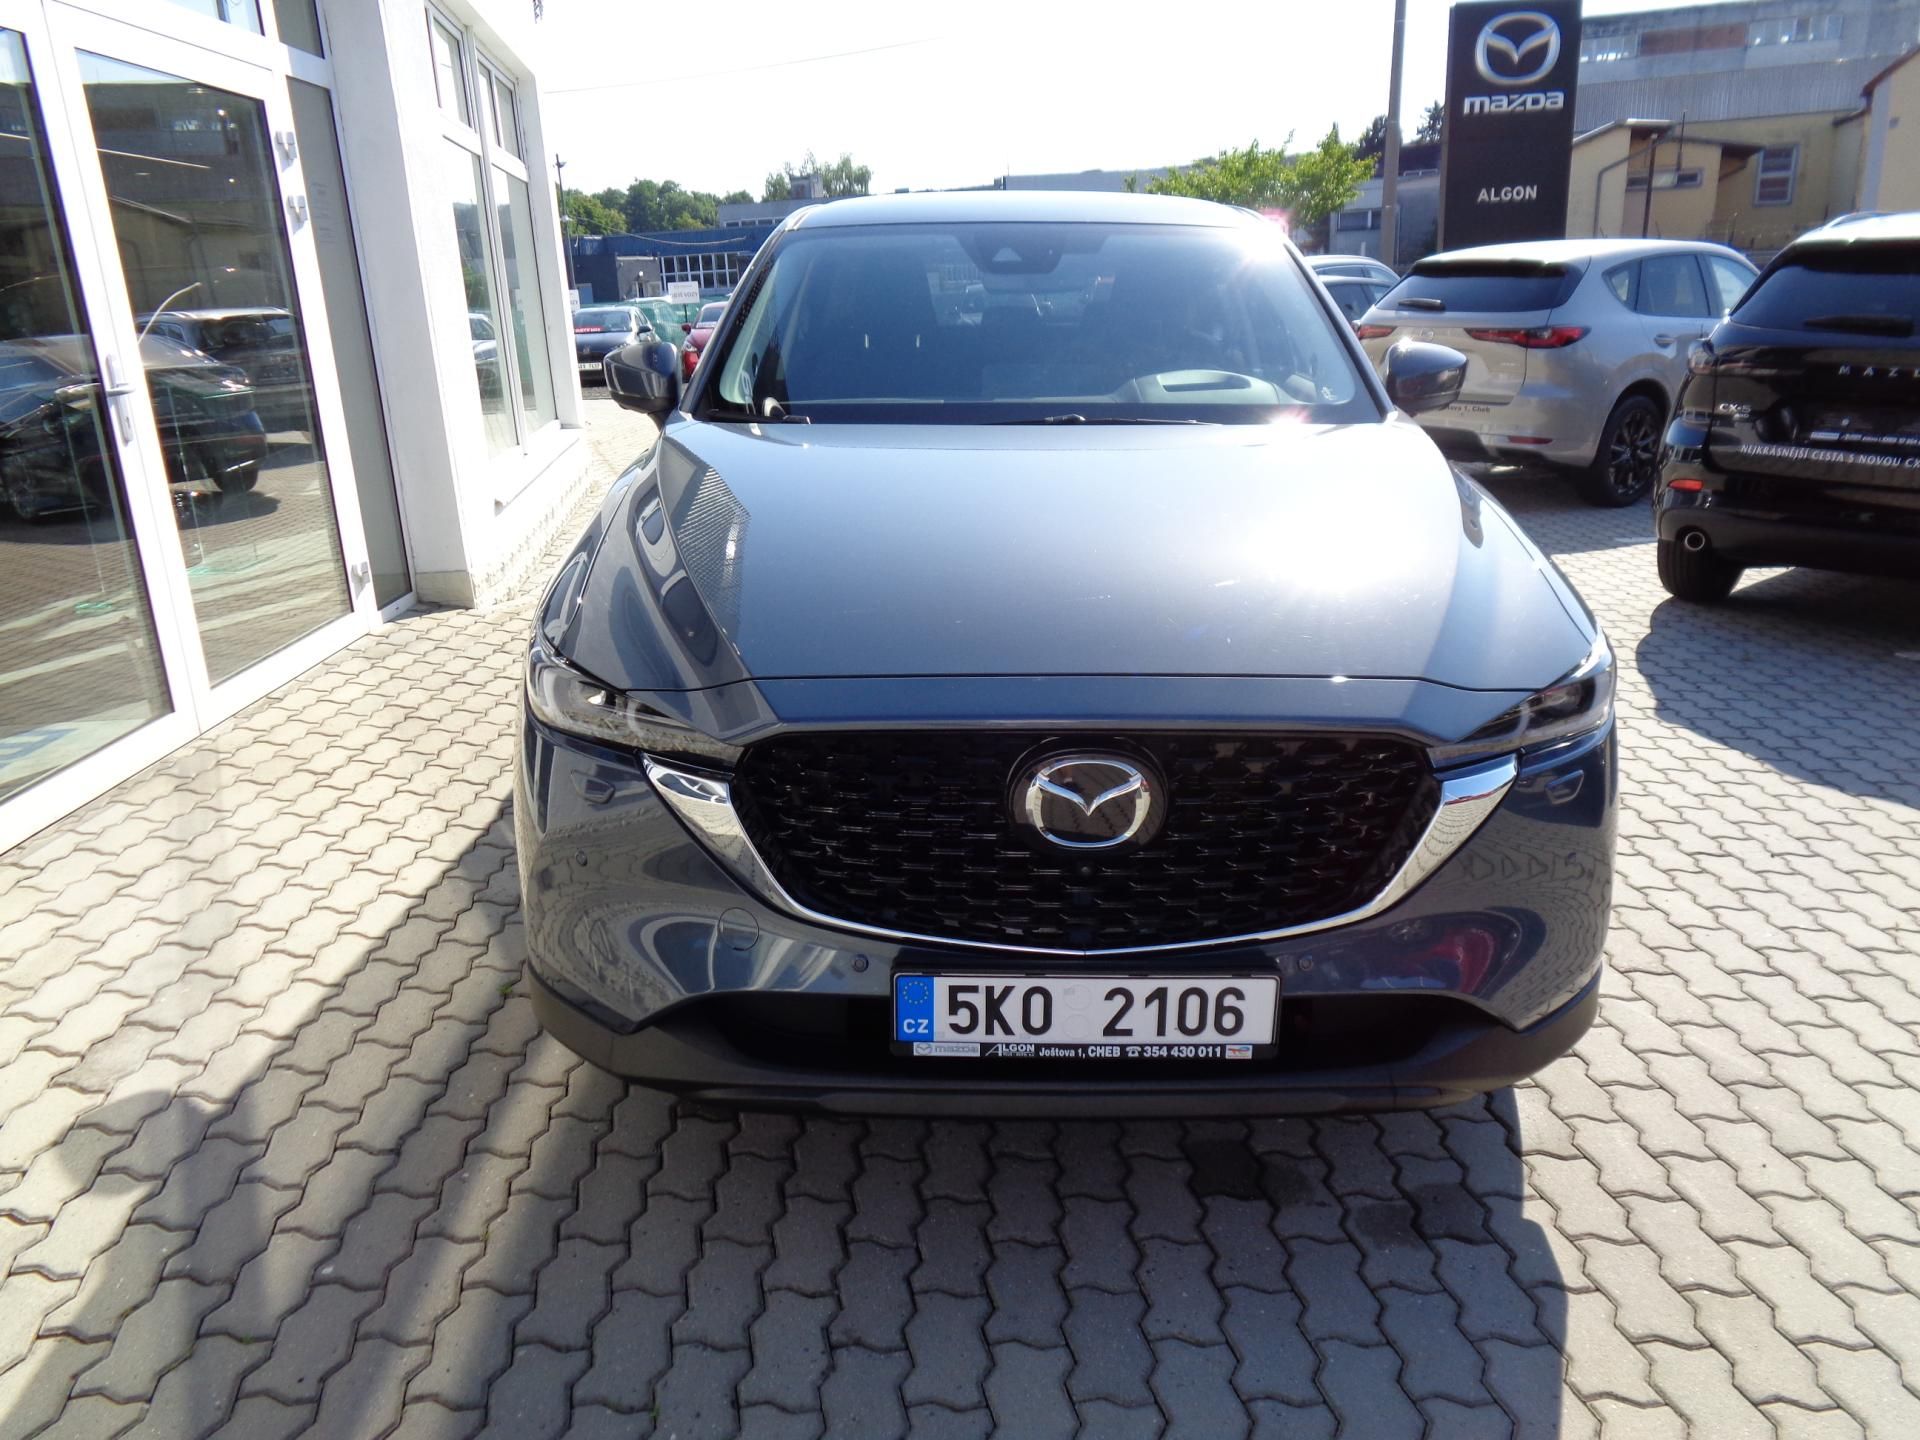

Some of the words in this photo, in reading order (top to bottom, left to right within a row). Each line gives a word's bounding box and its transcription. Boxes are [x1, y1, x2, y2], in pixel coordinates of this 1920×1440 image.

[1463, 91, 1564, 115] mazda
[1477, 184, 1538, 203] ALGON
[1719, 403, 1751, 413] CX-5
[1811, 450, 1844, 462] CESTA
[1859, 454, 1901, 467] NOVOU
[1103, 986, 1247, 1037] 2106
[903, 1018, 930, 1034] CZ
[985, 1043, 1035, 1056] ALGON
[1039, 1046, 1075, 1057] Joštova
[1088, 1046, 1121, 1057] CHEB
[1143, 1046, 1168, 1057] 354
[1171, 1046, 1195, 1057] 430
[1198, 1046, 1221, 1057] 011
